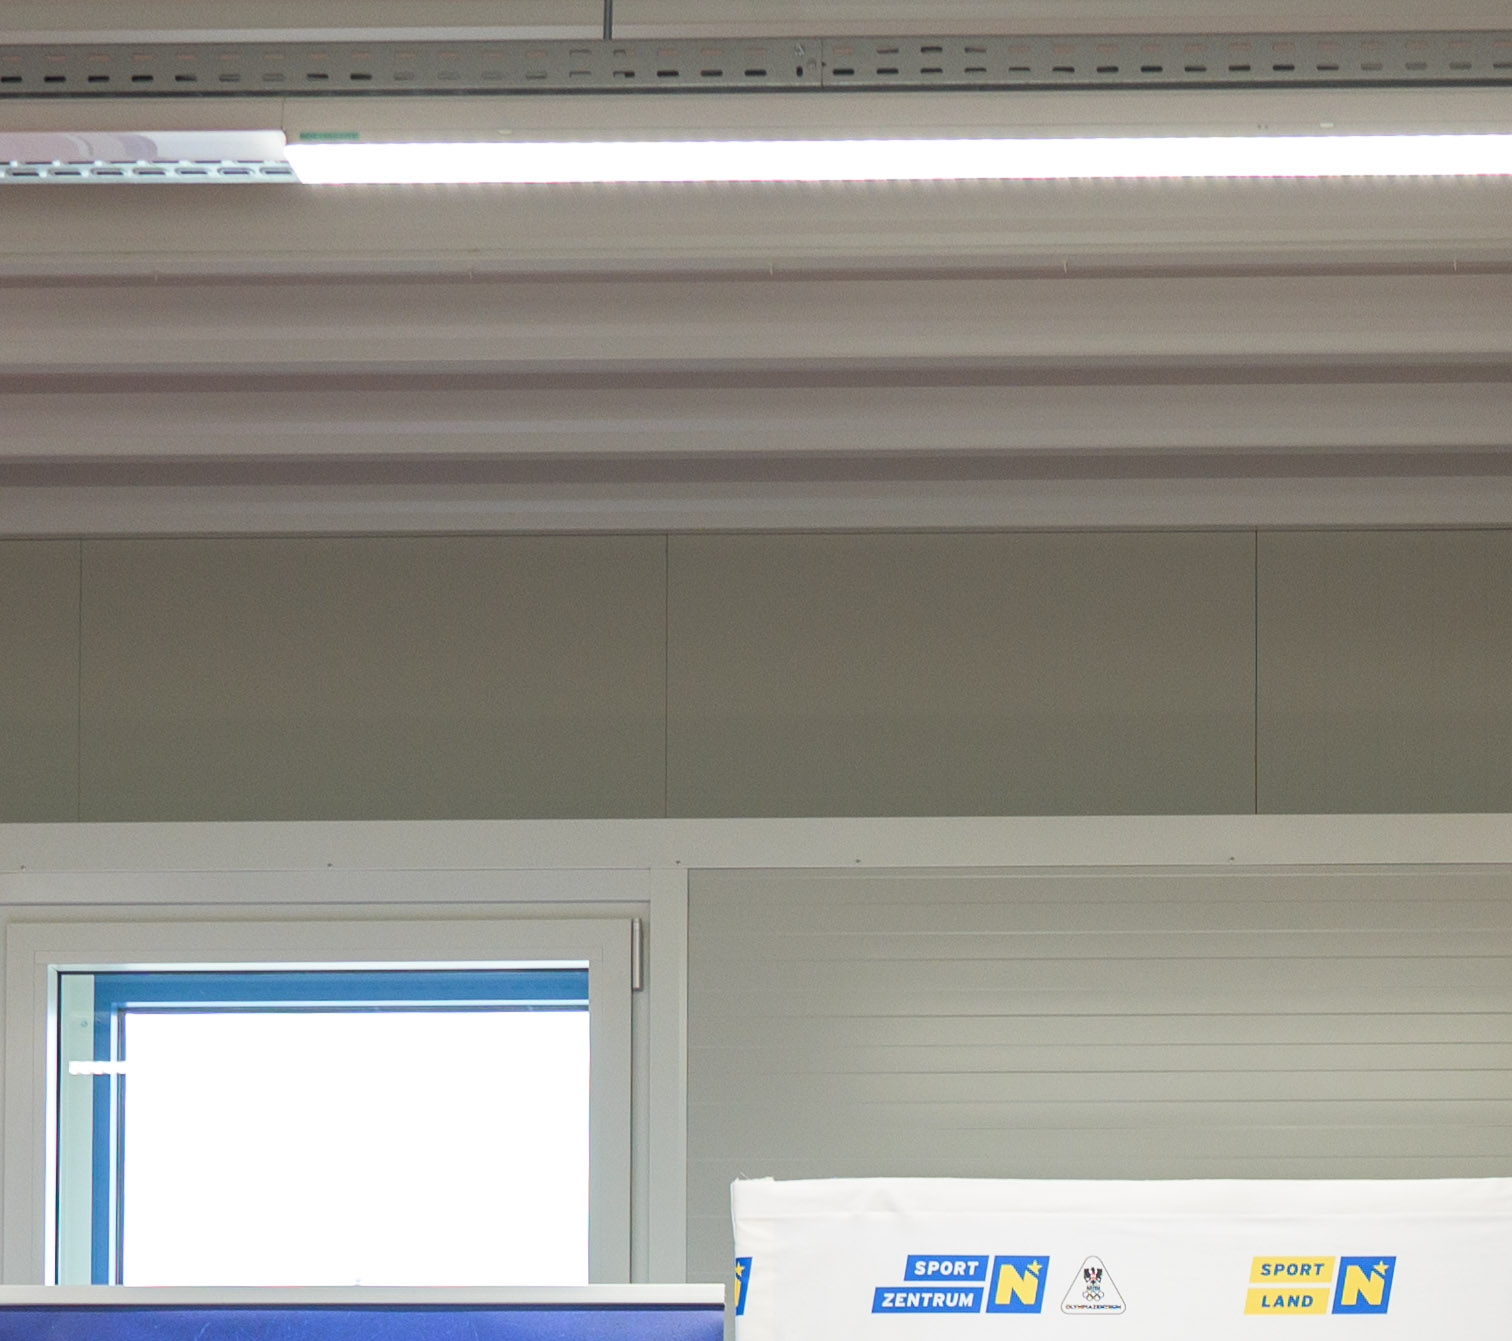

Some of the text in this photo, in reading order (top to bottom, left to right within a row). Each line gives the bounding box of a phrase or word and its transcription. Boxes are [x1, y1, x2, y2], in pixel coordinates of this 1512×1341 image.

[913, 1260, 980, 1277] SPORT
[1260, 1263, 1324, 1277] SPORT
[881, 1292, 975, 1308] ZENTRUM
[1260, 1294, 1314, 1308] LAND
